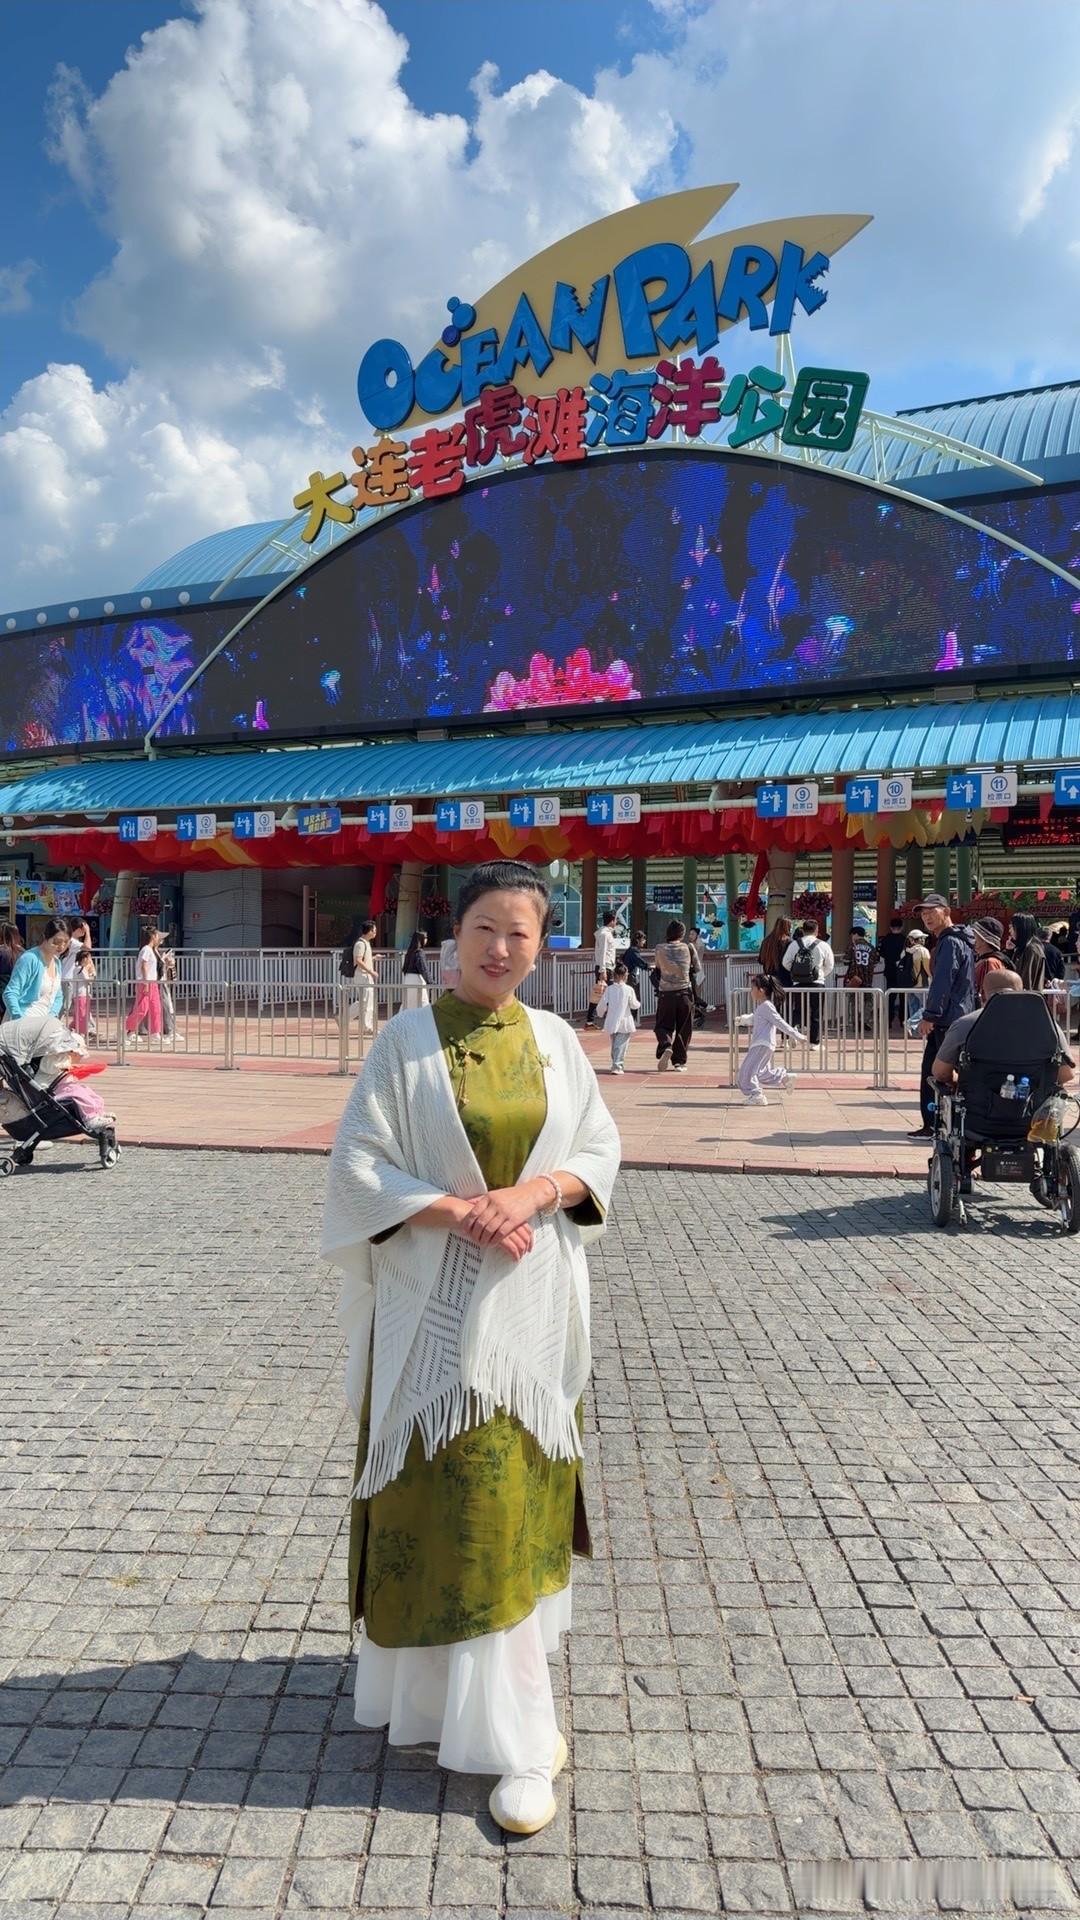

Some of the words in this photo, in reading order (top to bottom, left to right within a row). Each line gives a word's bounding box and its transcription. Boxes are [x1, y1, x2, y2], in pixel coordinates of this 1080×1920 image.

[358, 274, 611, 433] OCEAN
[613, 240, 831, 359] PARK
[293, 356, 870, 544] 大连老虎滩海洋公园
[855, 950, 870, 966] 93
